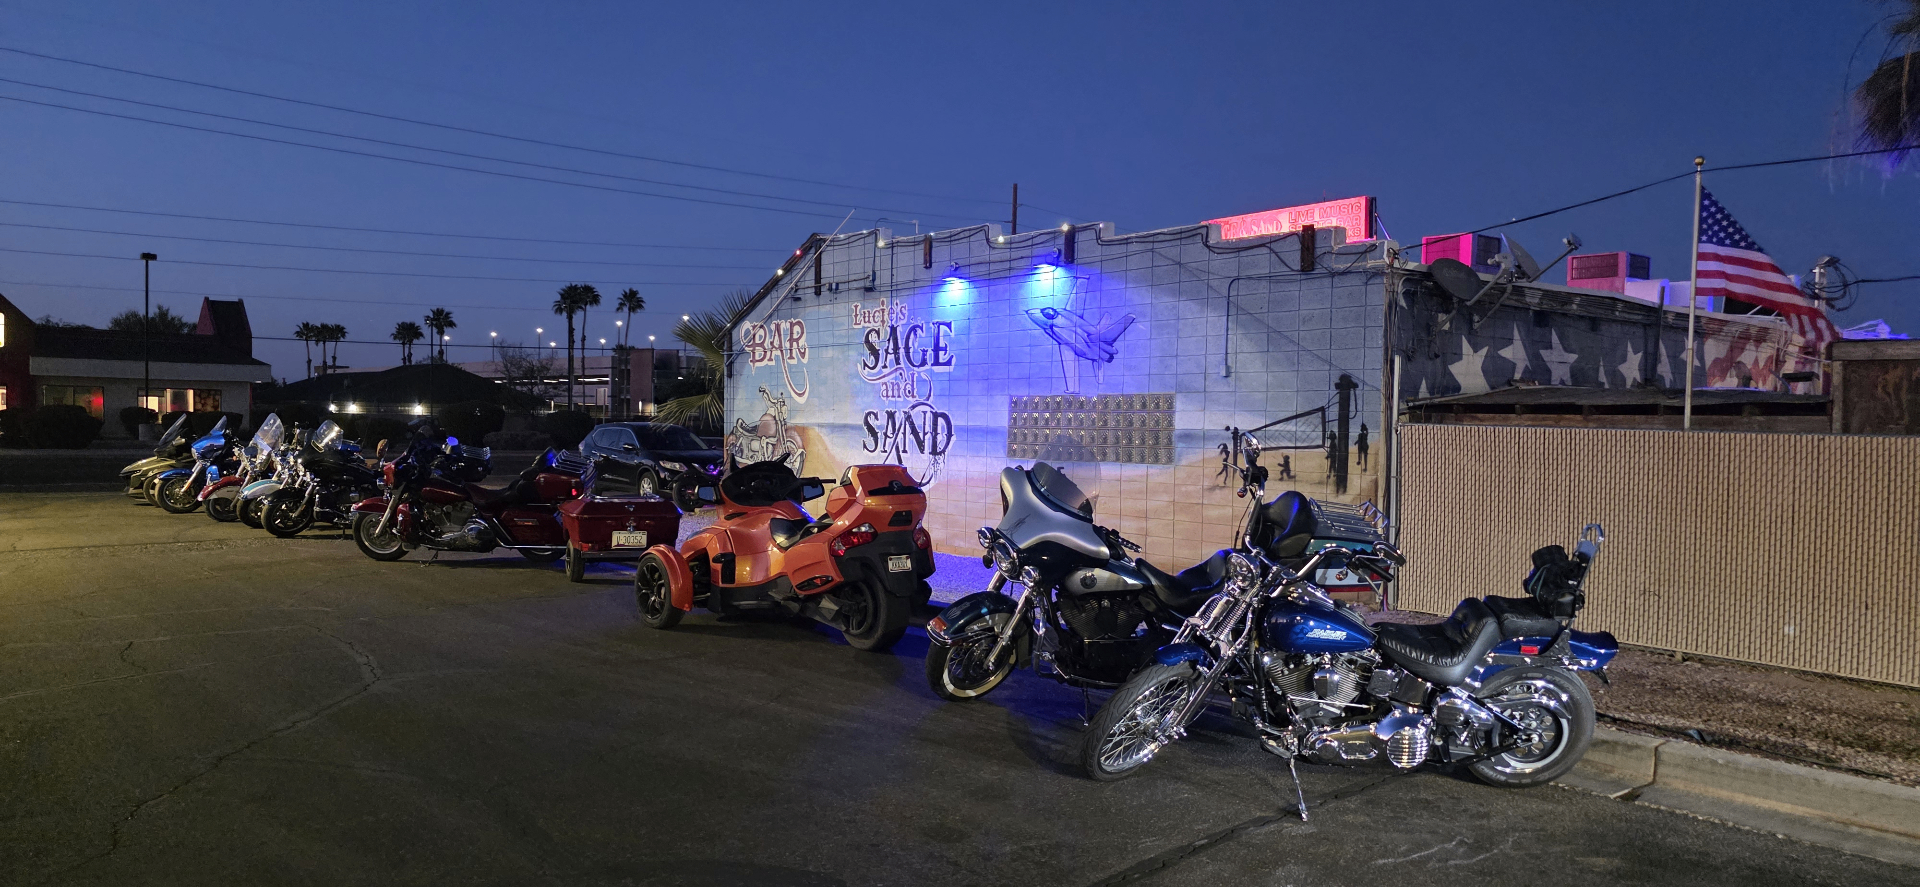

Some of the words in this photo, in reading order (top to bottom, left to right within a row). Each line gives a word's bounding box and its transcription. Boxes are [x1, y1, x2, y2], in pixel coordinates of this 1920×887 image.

[1288, 208, 1315, 224] LIVE
[1319, 202, 1362, 219] MUSIC
[1336, 215, 1362, 227] BAR
[862, 321, 955, 371] SAGE
[880, 371, 920, 400] and
[862, 408, 954, 466] SAND
